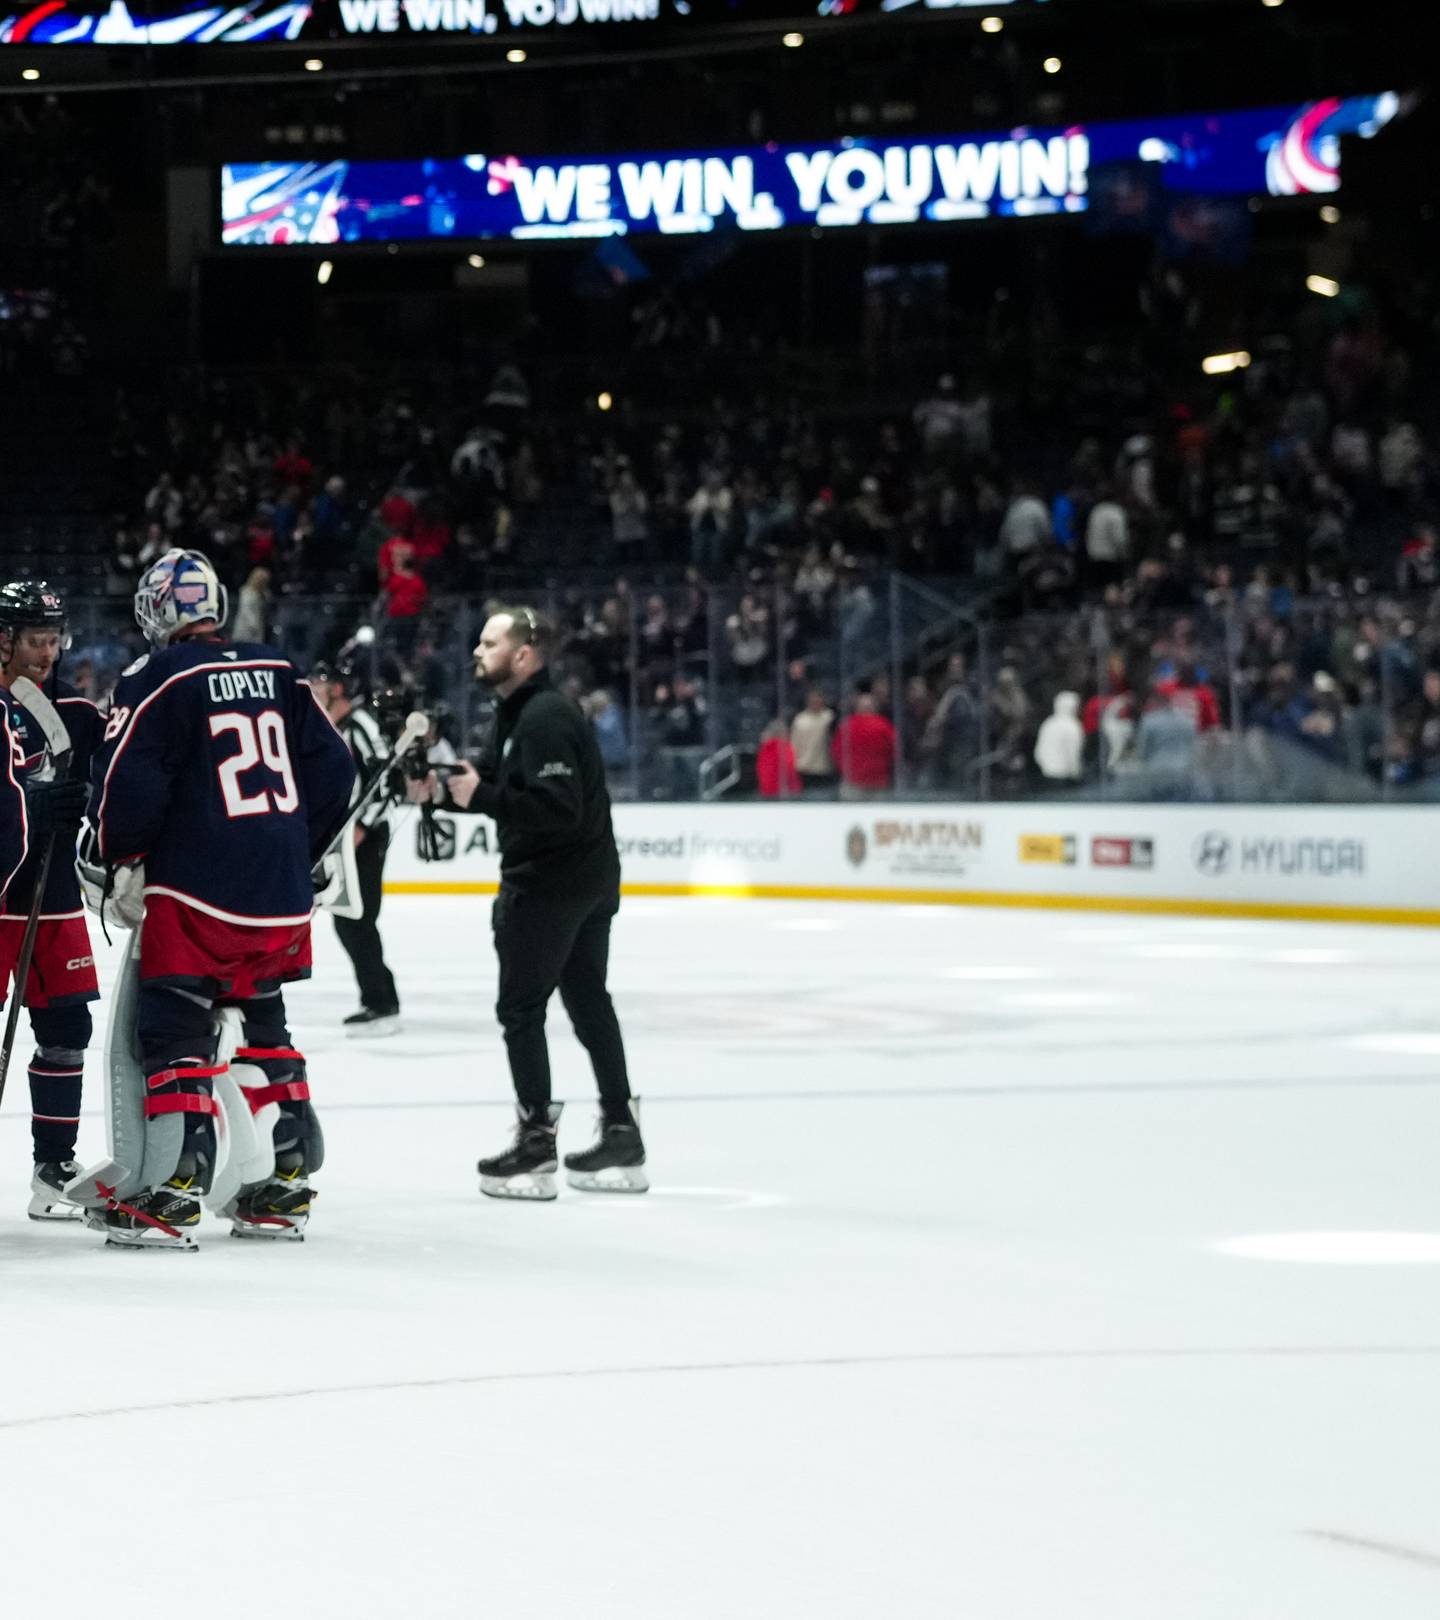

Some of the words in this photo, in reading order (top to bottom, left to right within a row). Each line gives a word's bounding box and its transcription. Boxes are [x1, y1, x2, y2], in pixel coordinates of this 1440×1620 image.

[339, 0, 399, 33] WE
[403, 0, 498, 35] WIN,
[512, 163, 612, 223] WE
[617, 155, 778, 220] WIN,
[786, 145, 932, 212] YOU
[933, 133, 1090, 206] WIN!
[208, 670, 275, 703] COPLEY
[209, 709, 300, 819] 29
[873, 820, 983, 848] SPARTAN
[1240, 837, 1365, 876] HYUNDAI
[66, 955, 95, 970] CC
[113, 1064, 123, 1148] CATALYST
[162, 1199, 191, 1216] CCM
